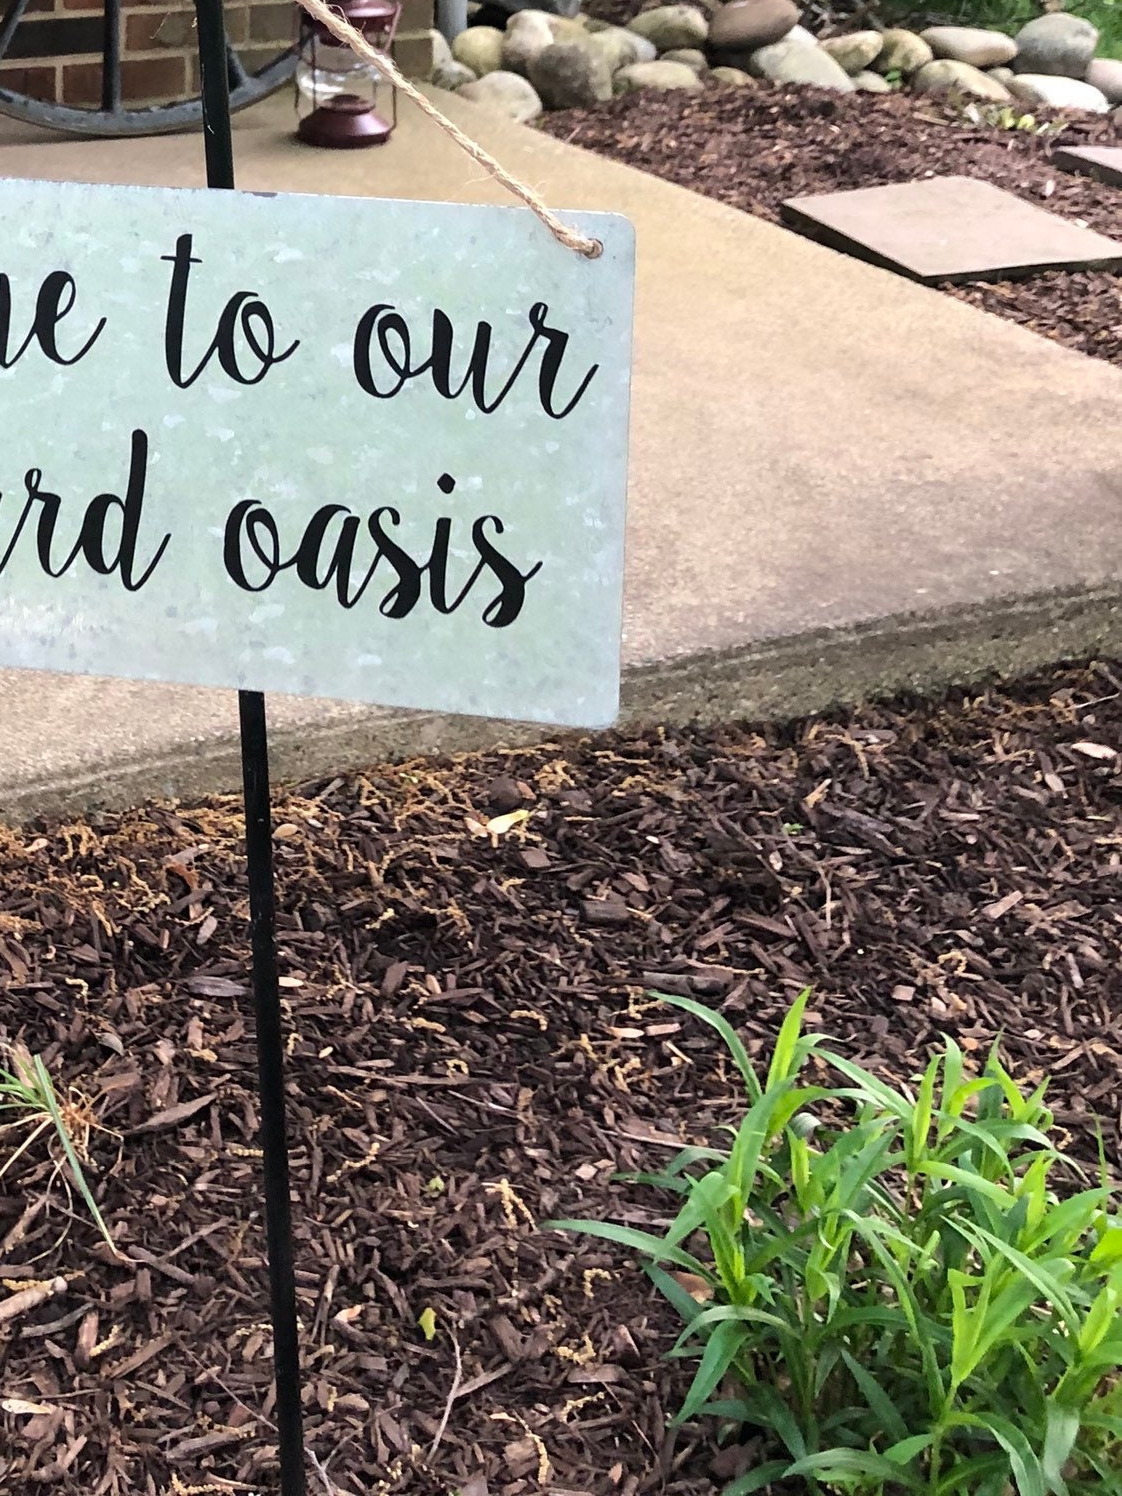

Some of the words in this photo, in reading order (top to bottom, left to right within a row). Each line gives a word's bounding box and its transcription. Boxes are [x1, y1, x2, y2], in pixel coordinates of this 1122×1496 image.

[161, 233, 301, 389] to
[353, 301, 600, 420] our
[223, 473, 543, 629] oasis
